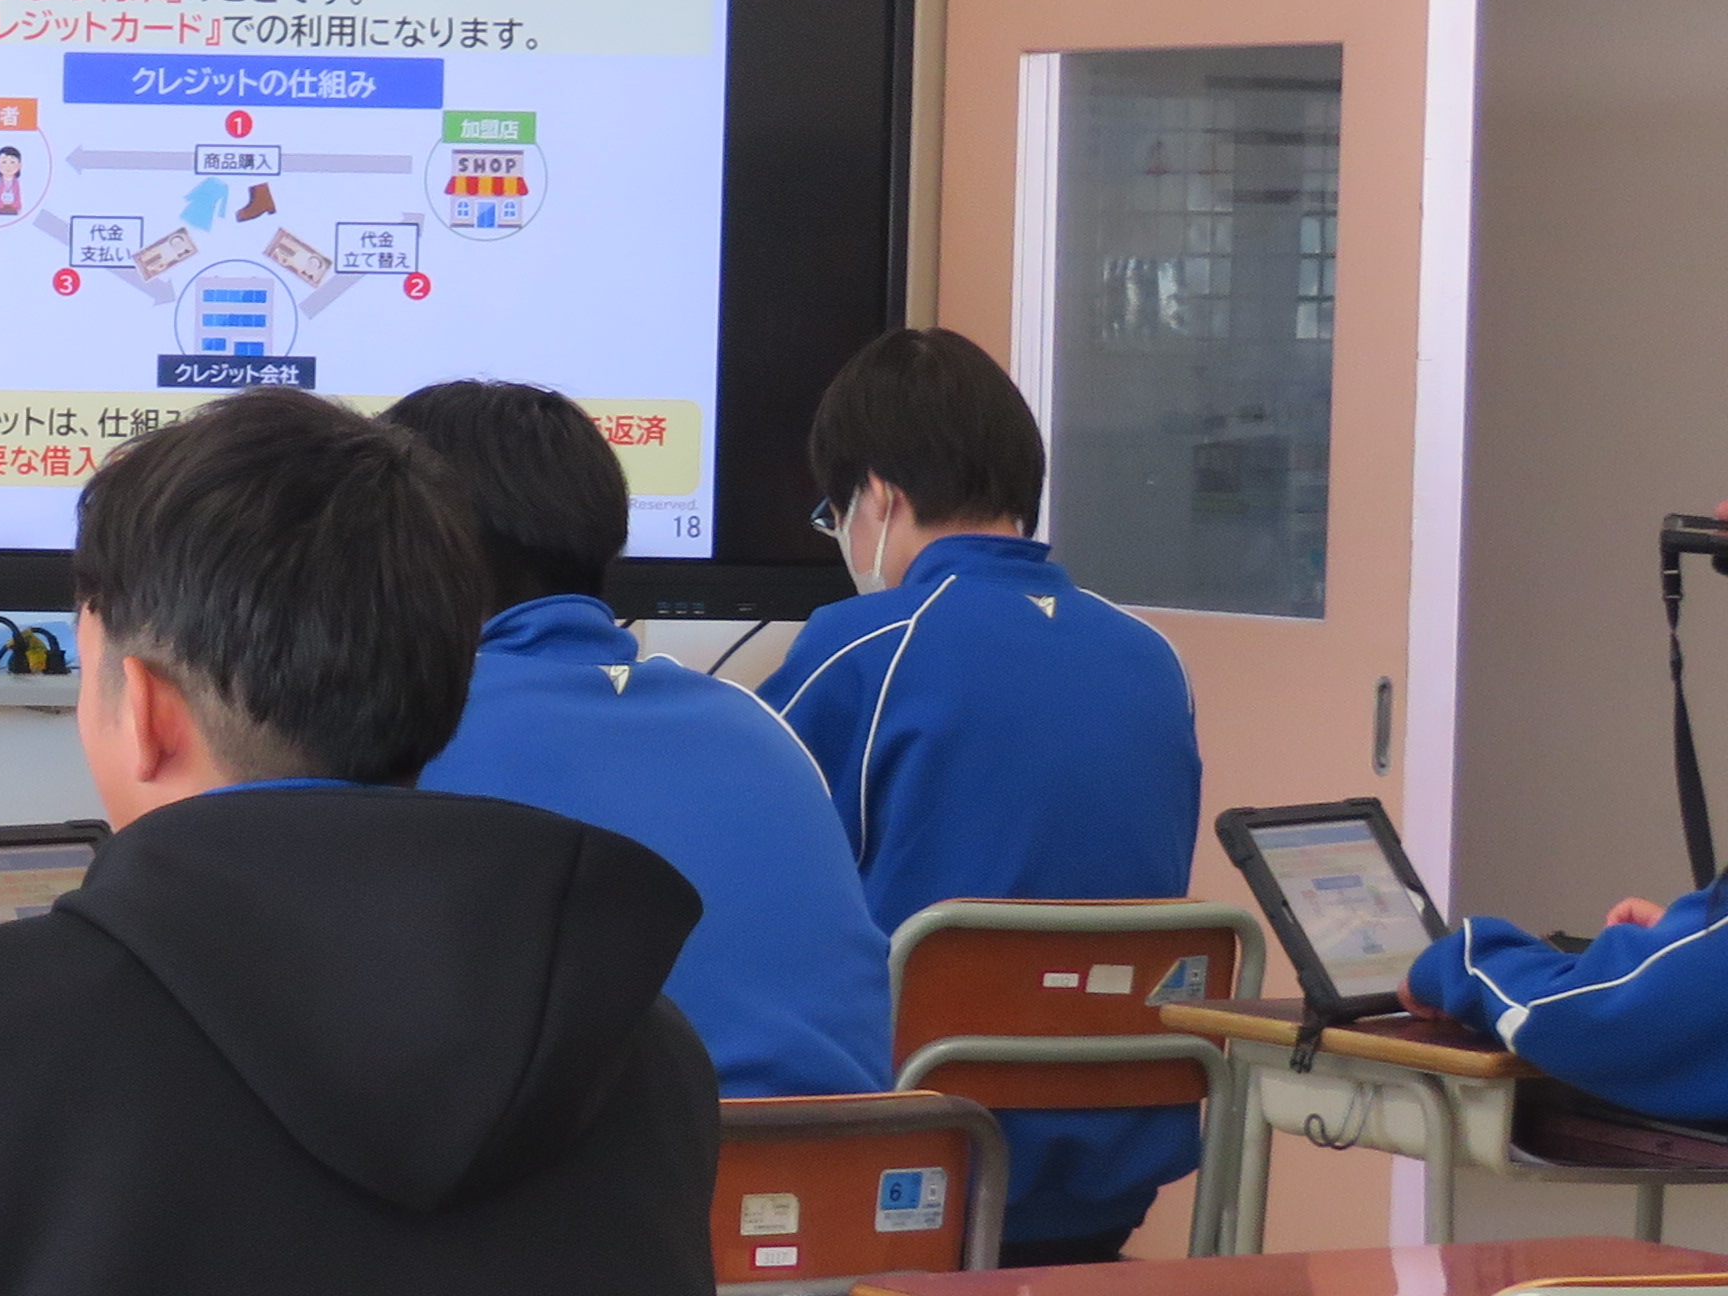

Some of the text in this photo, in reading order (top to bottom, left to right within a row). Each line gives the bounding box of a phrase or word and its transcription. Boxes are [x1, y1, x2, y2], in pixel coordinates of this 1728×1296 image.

[130, 63, 377, 100] クレジットの仕組み
[460, 119, 520, 141] 加盟店
[203, 151, 274, 172] 商品購入
[457, 154, 519, 176] SHOP
[89, 224, 124, 244] 代金
[360, 231, 395, 250] 代金
[80, 245, 132, 265] 支払い
[343, 250, 412, 271] 立て替え
[59, 273, 74, 294] 3
[409, 277, 425, 298] 2
[174, 362, 301, 388] クレジット会社
[588, 415, 667, 447] 返済
[672, 515, 702, 539] 18
[890, 1182, 903, 1202] 6
